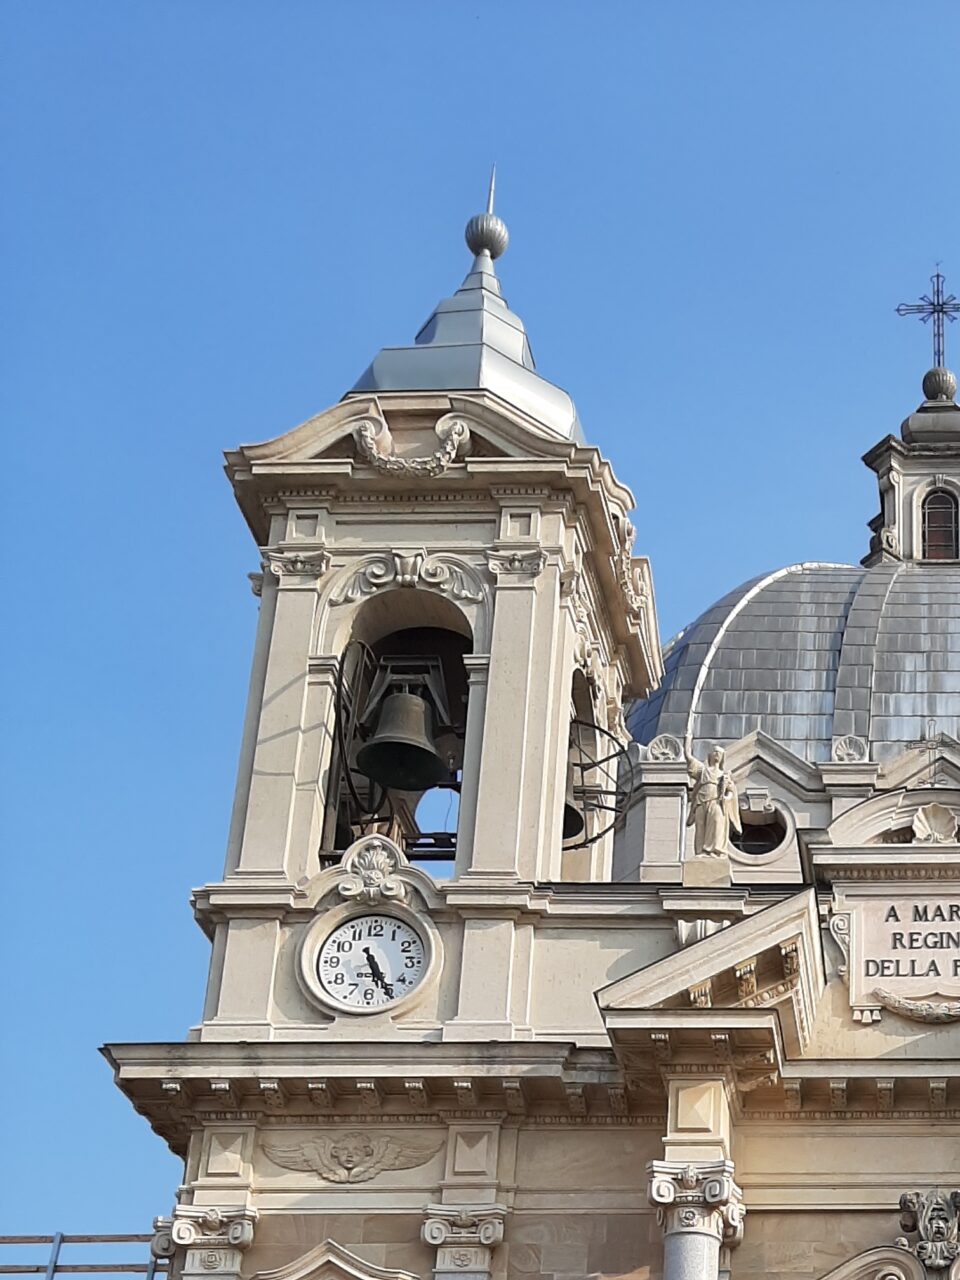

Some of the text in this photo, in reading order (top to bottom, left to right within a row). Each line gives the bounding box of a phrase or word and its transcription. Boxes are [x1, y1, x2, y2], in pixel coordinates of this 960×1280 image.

[884, 905, 901, 923] A
[352, 928, 362, 941] 11
[367, 924, 384, 937] 12
[391, 928, 397, 941] 1
[336, 940, 352, 953] 10
[401, 940, 412, 953] 2
[329, 956, 340, 968] 9
[405, 956, 416, 969] 3
[864, 959, 941, 977] DELLA
[334, 973, 345, 985] 8
[396, 972, 407, 985] 4
[348, 983, 359, 996] 7
[364, 988, 375, 1000] 6
